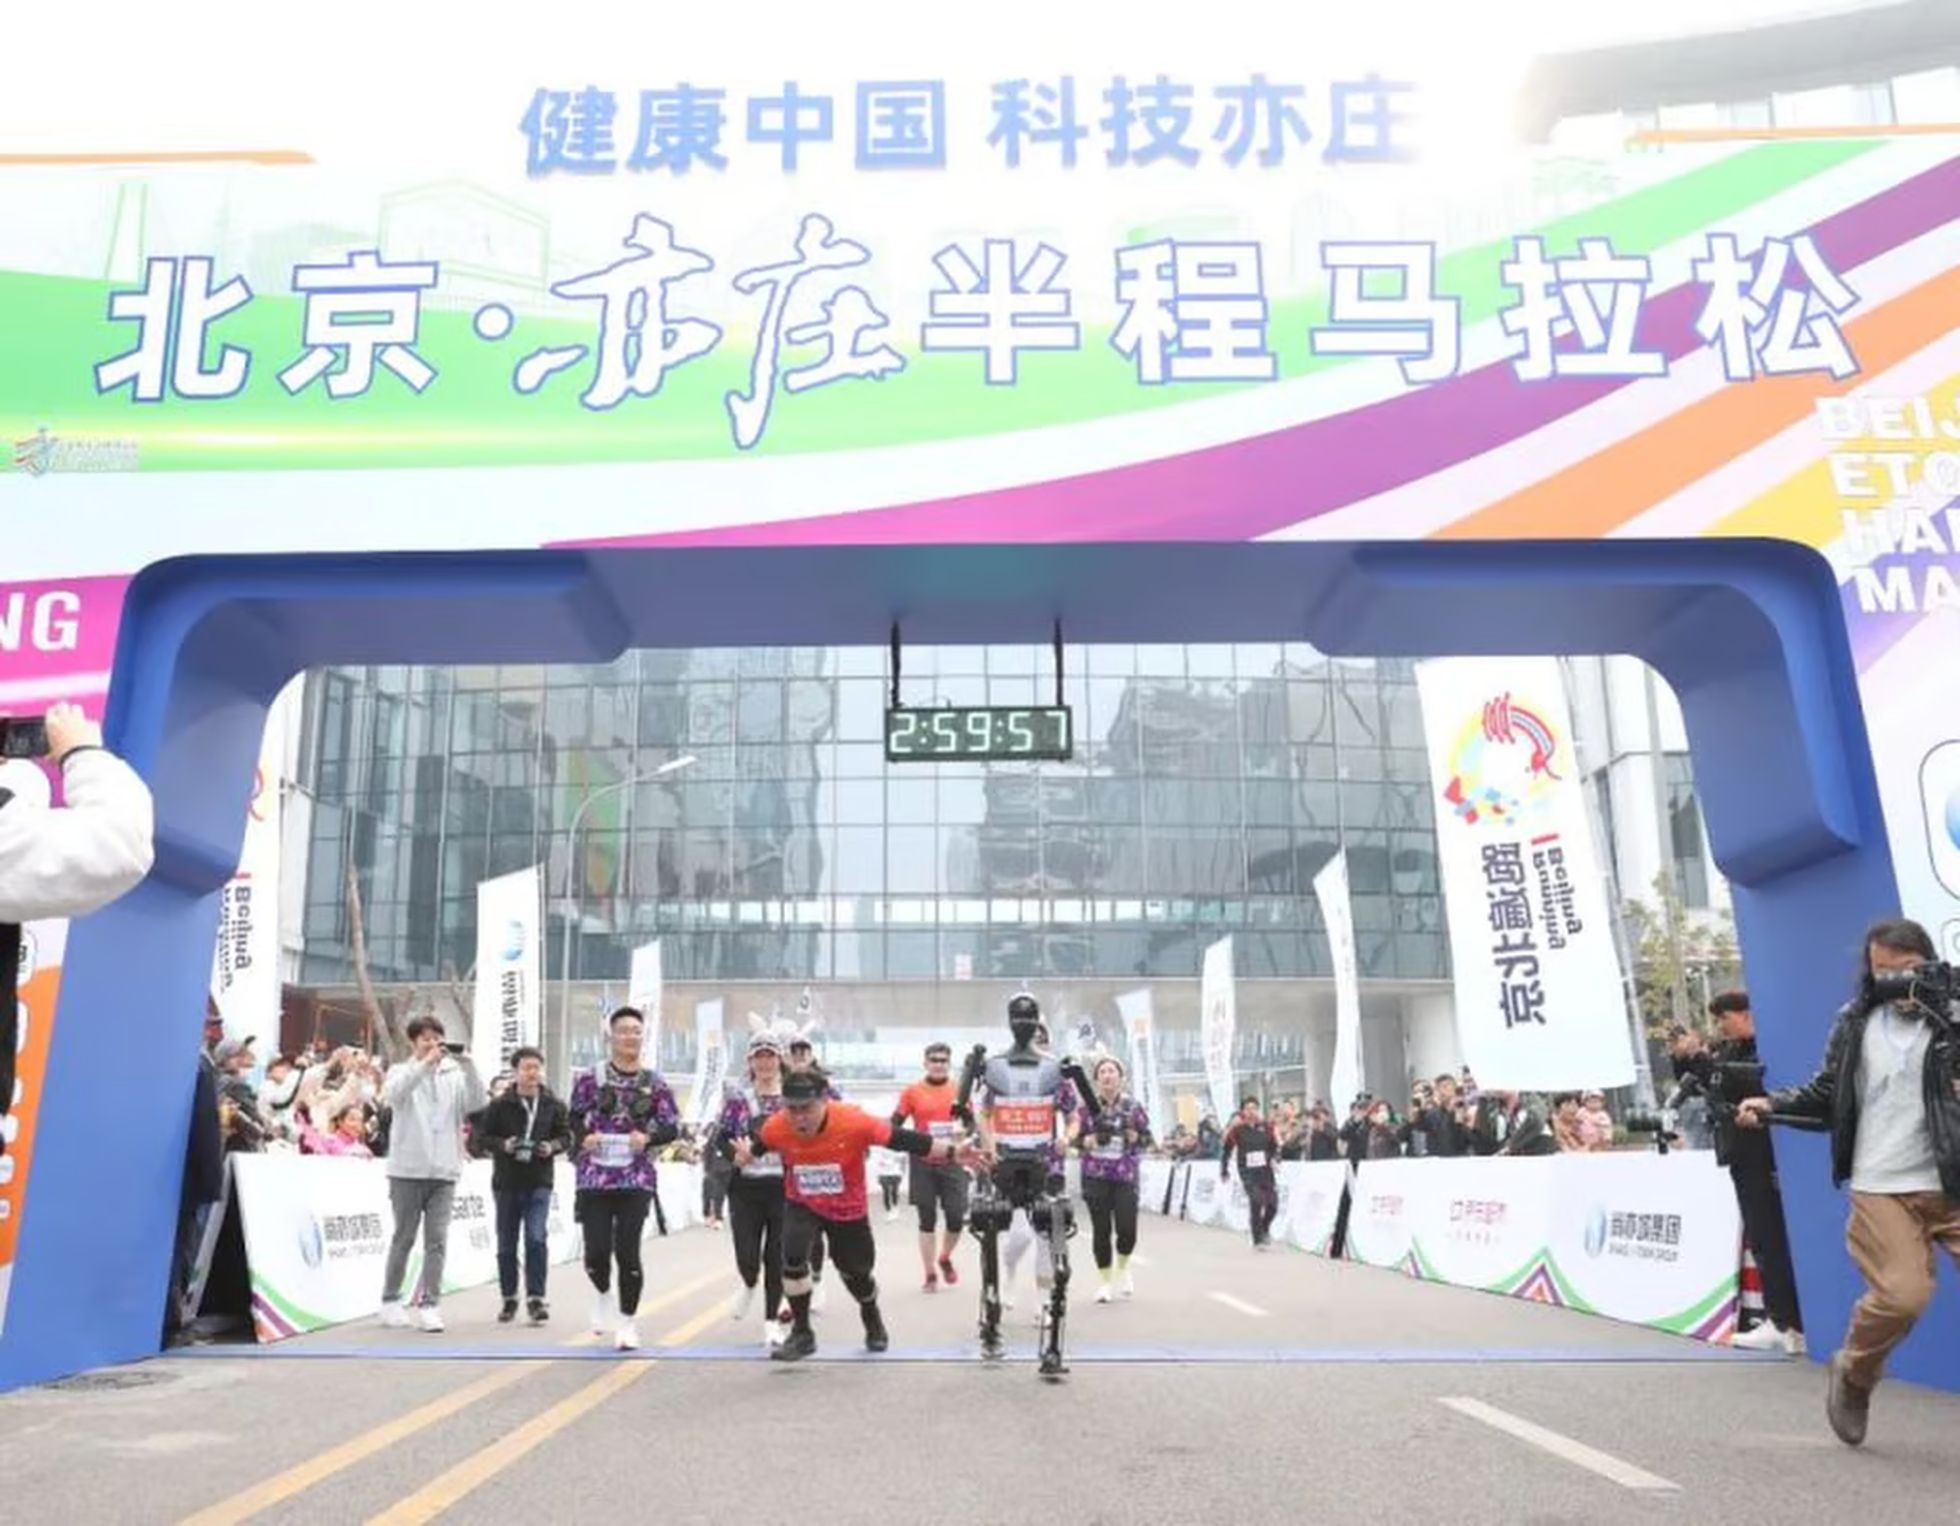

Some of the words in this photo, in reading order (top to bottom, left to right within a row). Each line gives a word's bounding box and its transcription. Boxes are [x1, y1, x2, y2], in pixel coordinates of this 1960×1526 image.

[520, 80, 948, 177] 健康中国
[985, 74, 1420, 170] 科技亦庄
[889, 711, 1068, 753] 2:59:57
